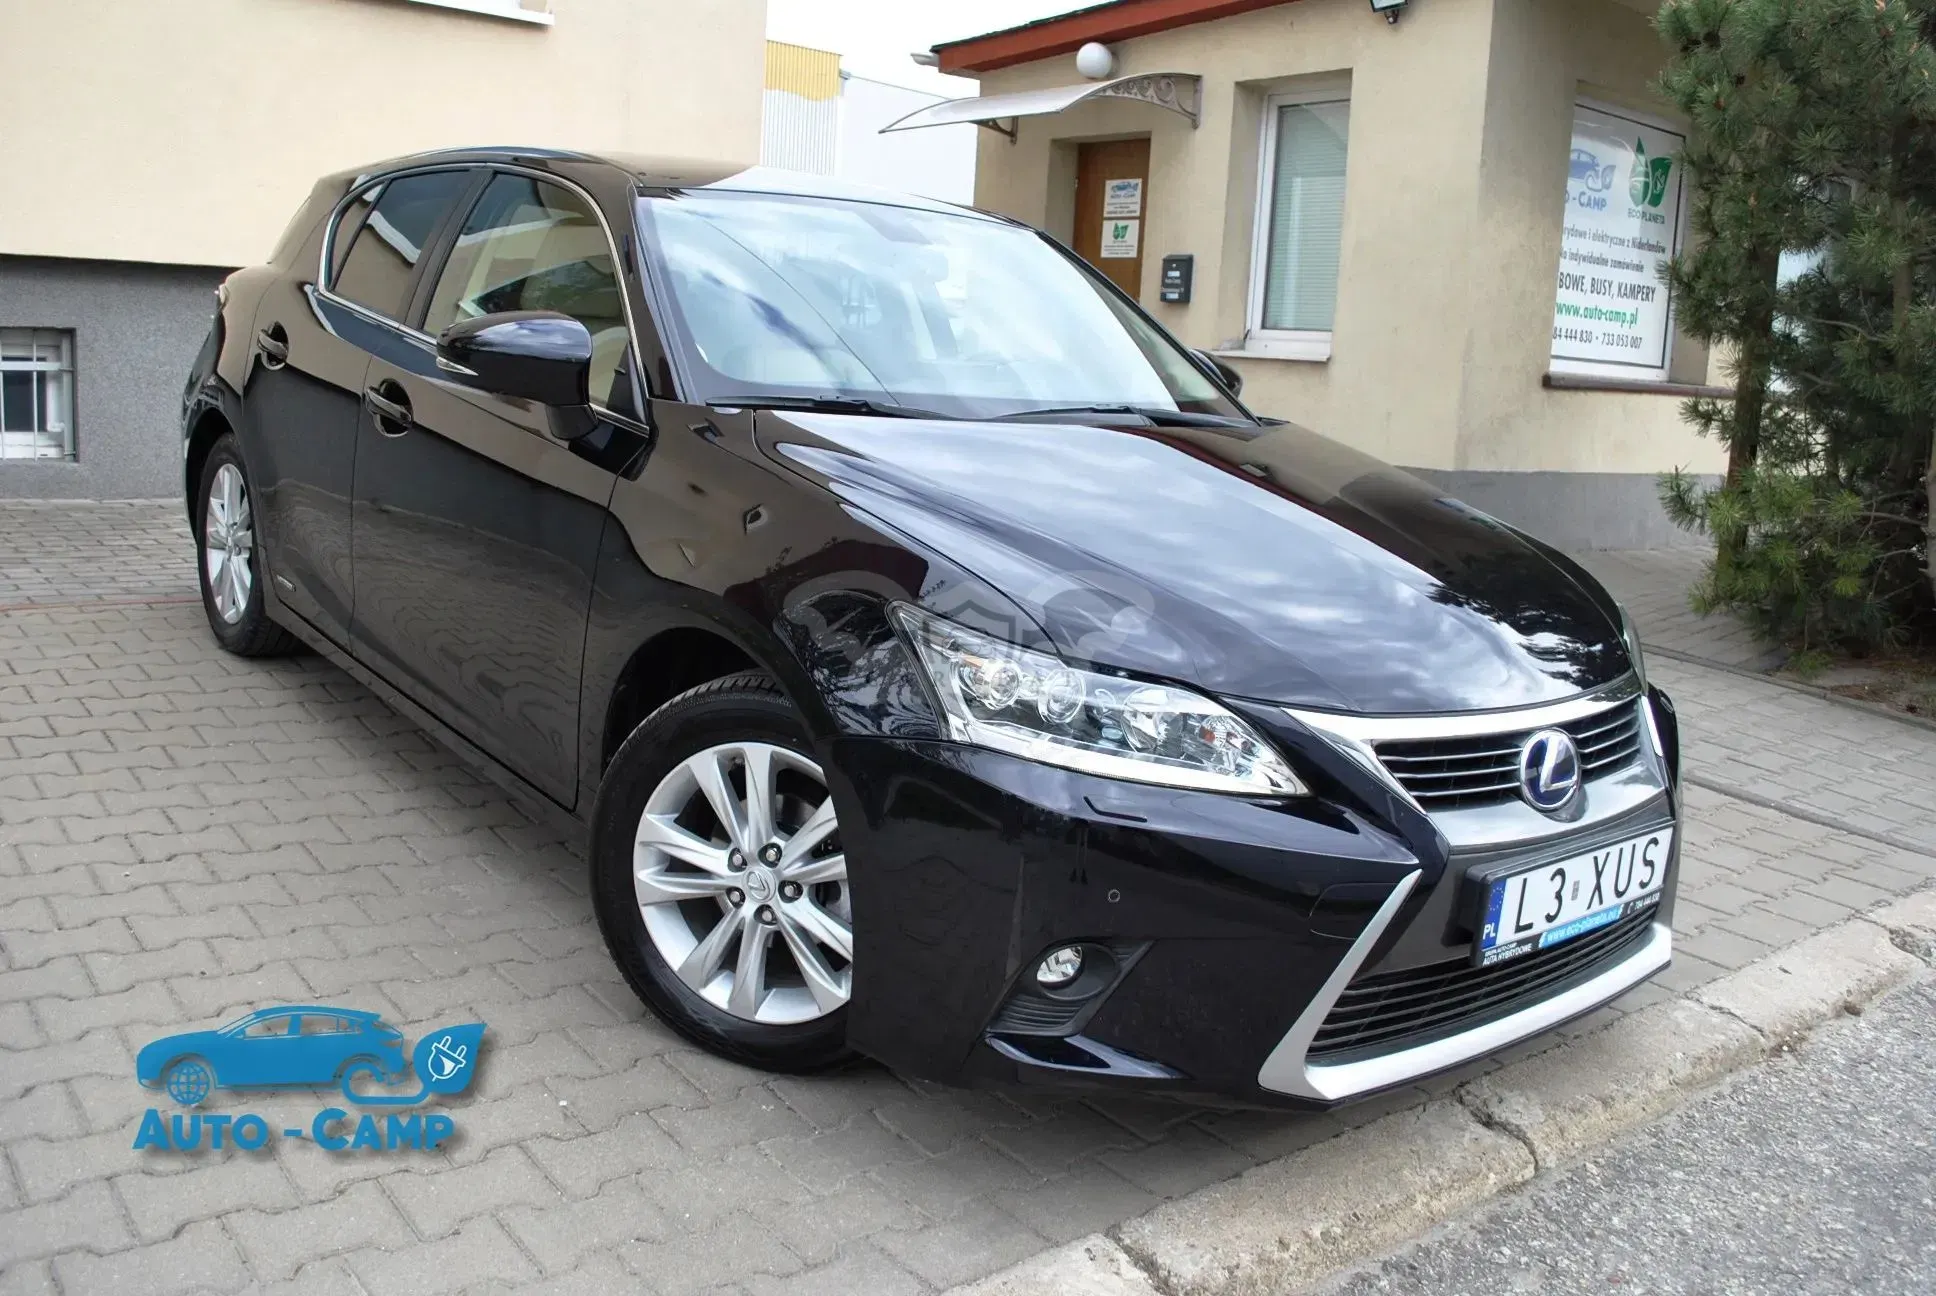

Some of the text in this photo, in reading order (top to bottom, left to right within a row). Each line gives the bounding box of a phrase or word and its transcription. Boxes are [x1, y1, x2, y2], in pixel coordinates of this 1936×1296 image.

[1578, 191, 1607, 211] CAMP
[1592, 228, 1625, 248] elektryczne
[1590, 277, 1614, 299] BUSY,
[1617, 281, 1656, 302] KAMPERY
[1555, 302, 1638, 329] www.auto-camp.pl
[1564, 328, 1578, 342] 444
[1579, 330, 1593, 344] 830
[1601, 332, 1614, 346] 733
[1616, 334, 1629, 348] 053
[1630, 336, 1643, 350] 007
[1514, 836, 1660, 935] L3 XUS
[1482, 922, 1496, 940] PL
